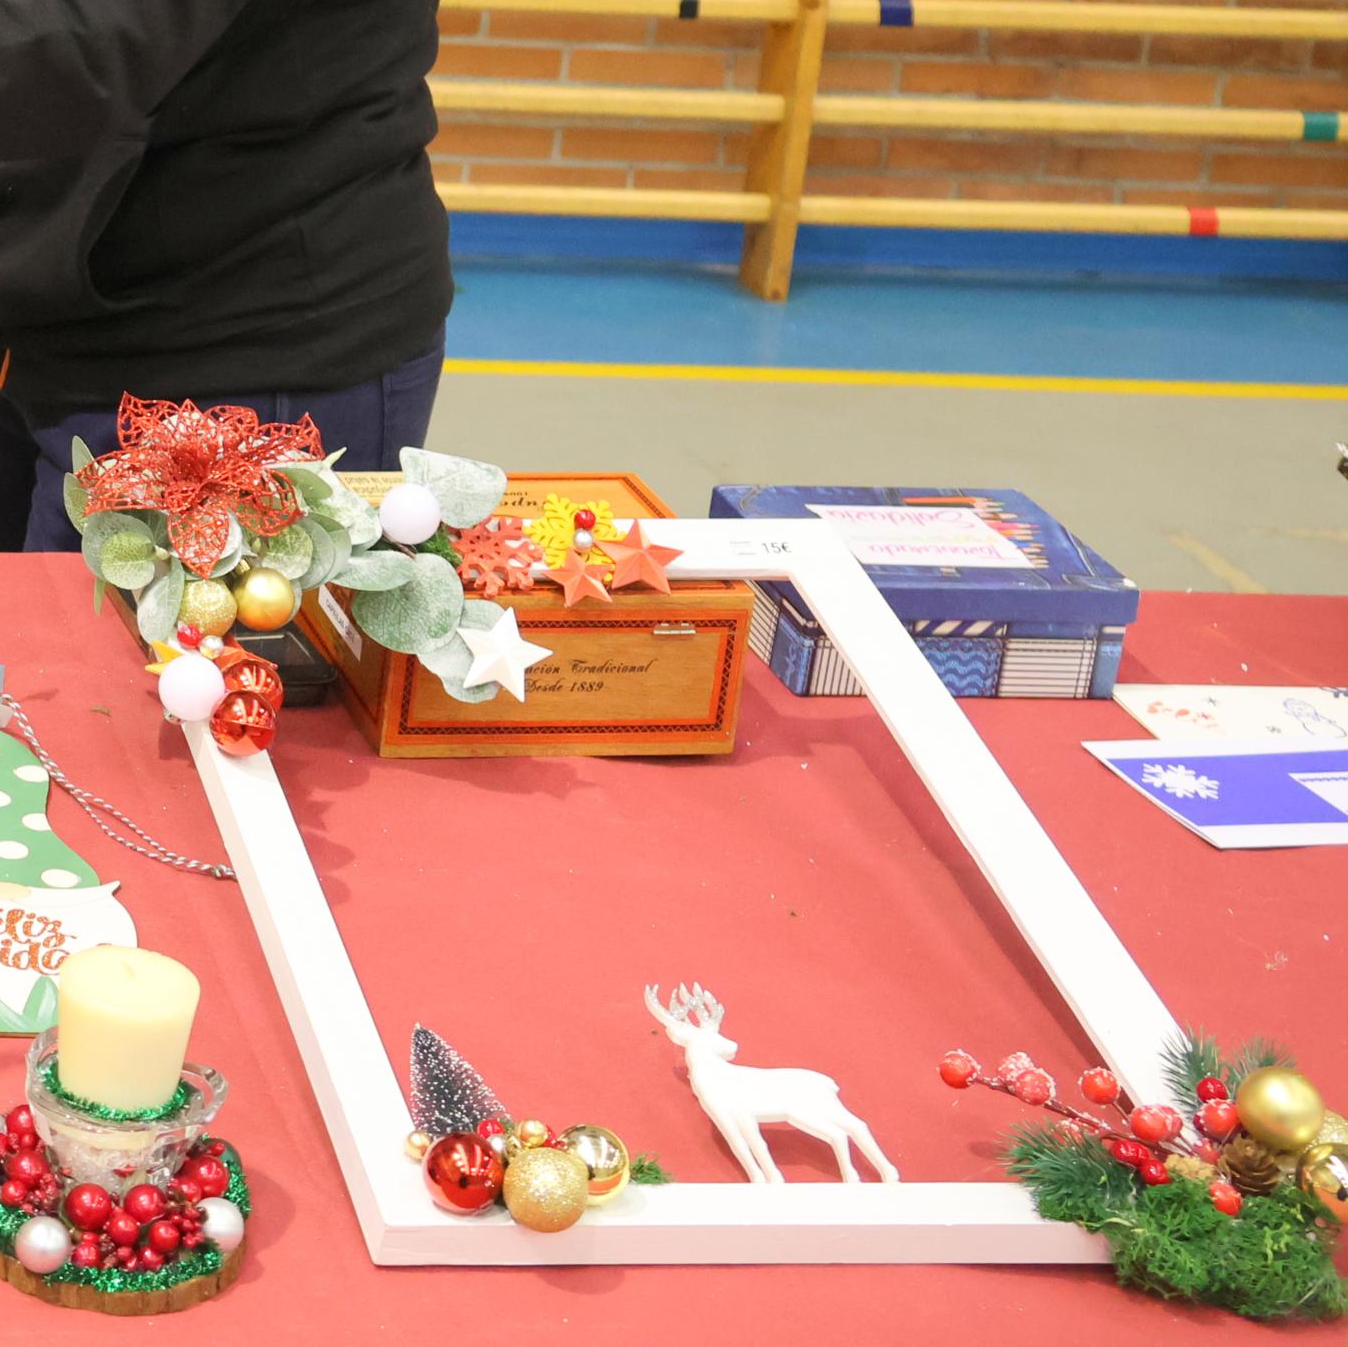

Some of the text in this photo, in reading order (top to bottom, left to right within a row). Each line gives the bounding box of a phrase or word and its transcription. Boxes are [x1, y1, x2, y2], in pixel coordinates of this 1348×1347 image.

[761, 542, 792, 554] 15€
[569, 658, 657, 674] Tradicional
[570, 680, 605, 693] 1889
